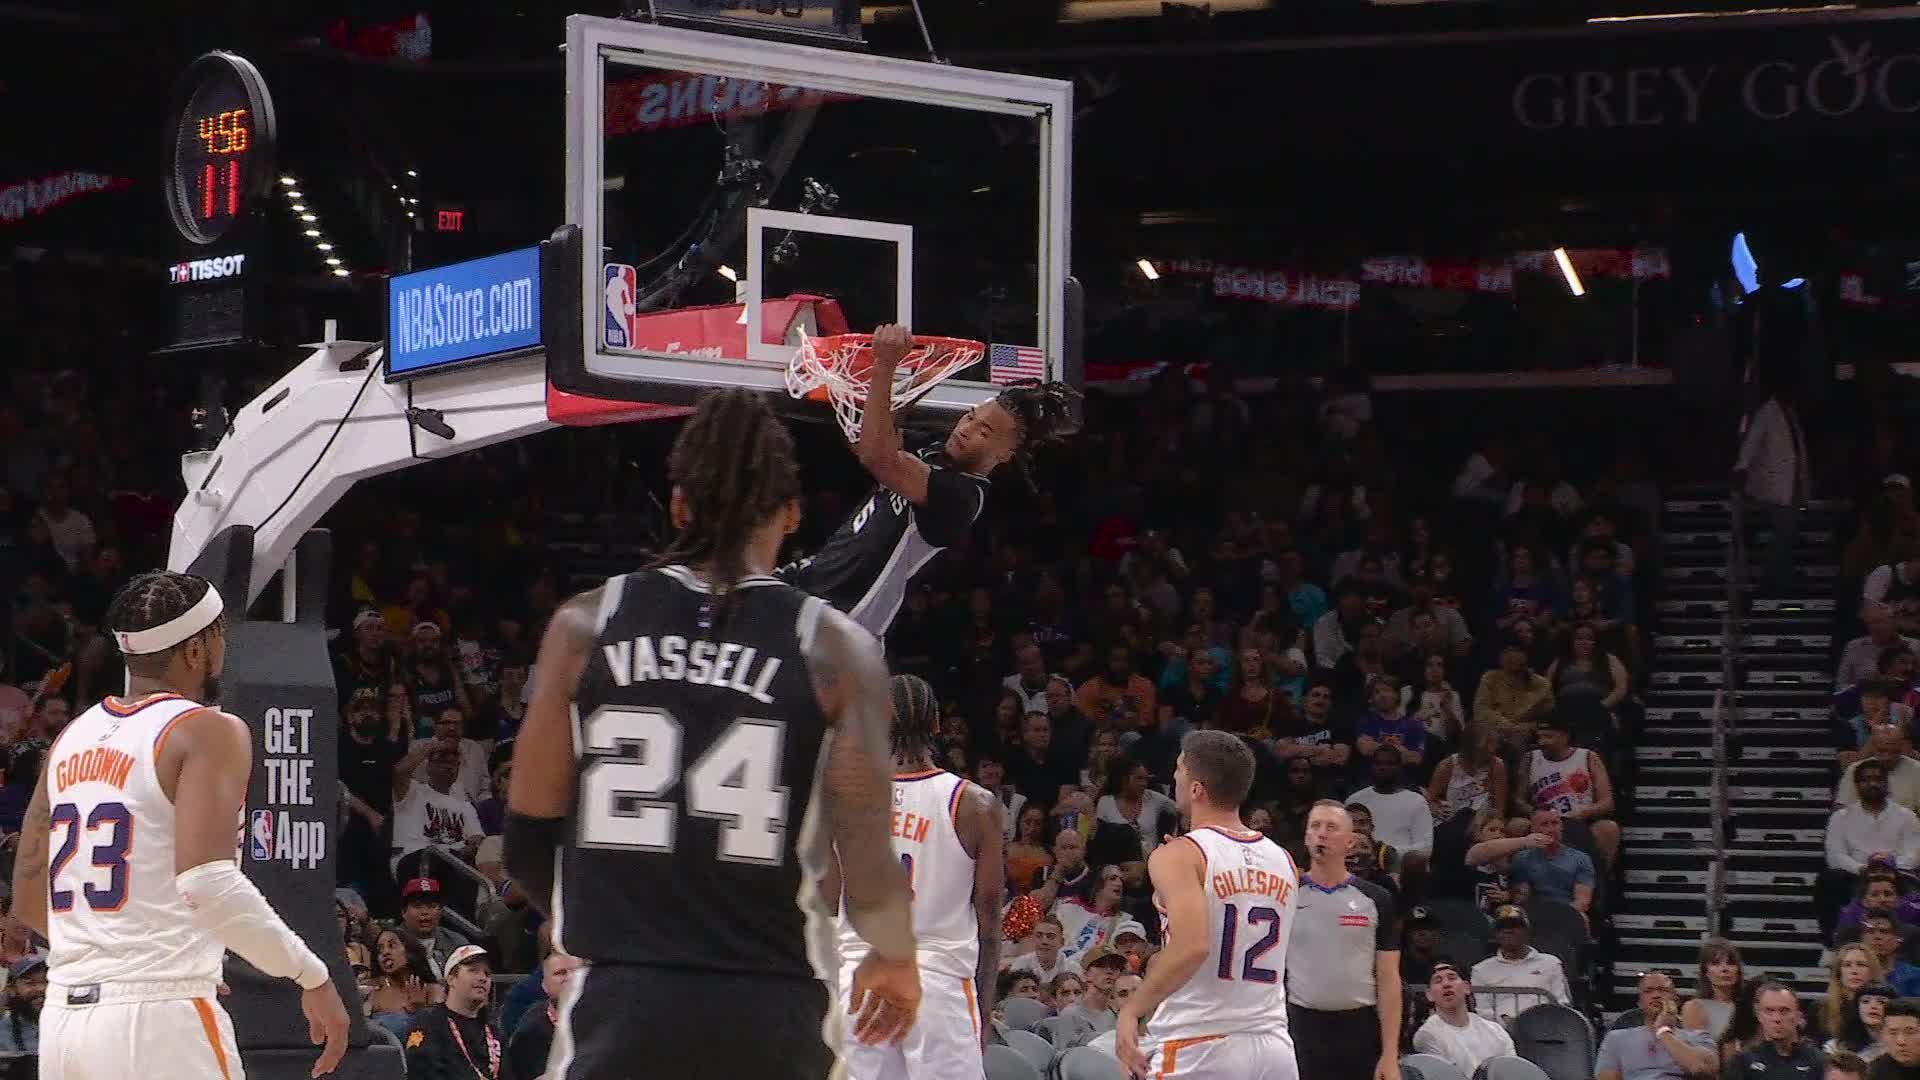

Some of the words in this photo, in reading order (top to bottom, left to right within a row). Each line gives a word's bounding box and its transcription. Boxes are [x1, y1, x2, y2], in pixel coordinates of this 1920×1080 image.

[1511, 65, 1717, 130] GREY
[204, 159, 240, 219] 11
[438, 210, 464, 232] EXIT
[398, 277, 532, 354] NBAStore.com
[603, 634, 783, 704] VASSELL
[264, 706, 314, 755] GET
[56, 748, 136, 793] GOODWIN
[264, 758, 314, 806] THE
[576, 703, 792, 868] 24
[49, 801, 134, 912] 23
[275, 810, 326, 870] App
[890, 810, 931, 843] EEN
[1213, 869, 1293, 906] GILLESPIE
[1218, 903, 1280, 985] 12
